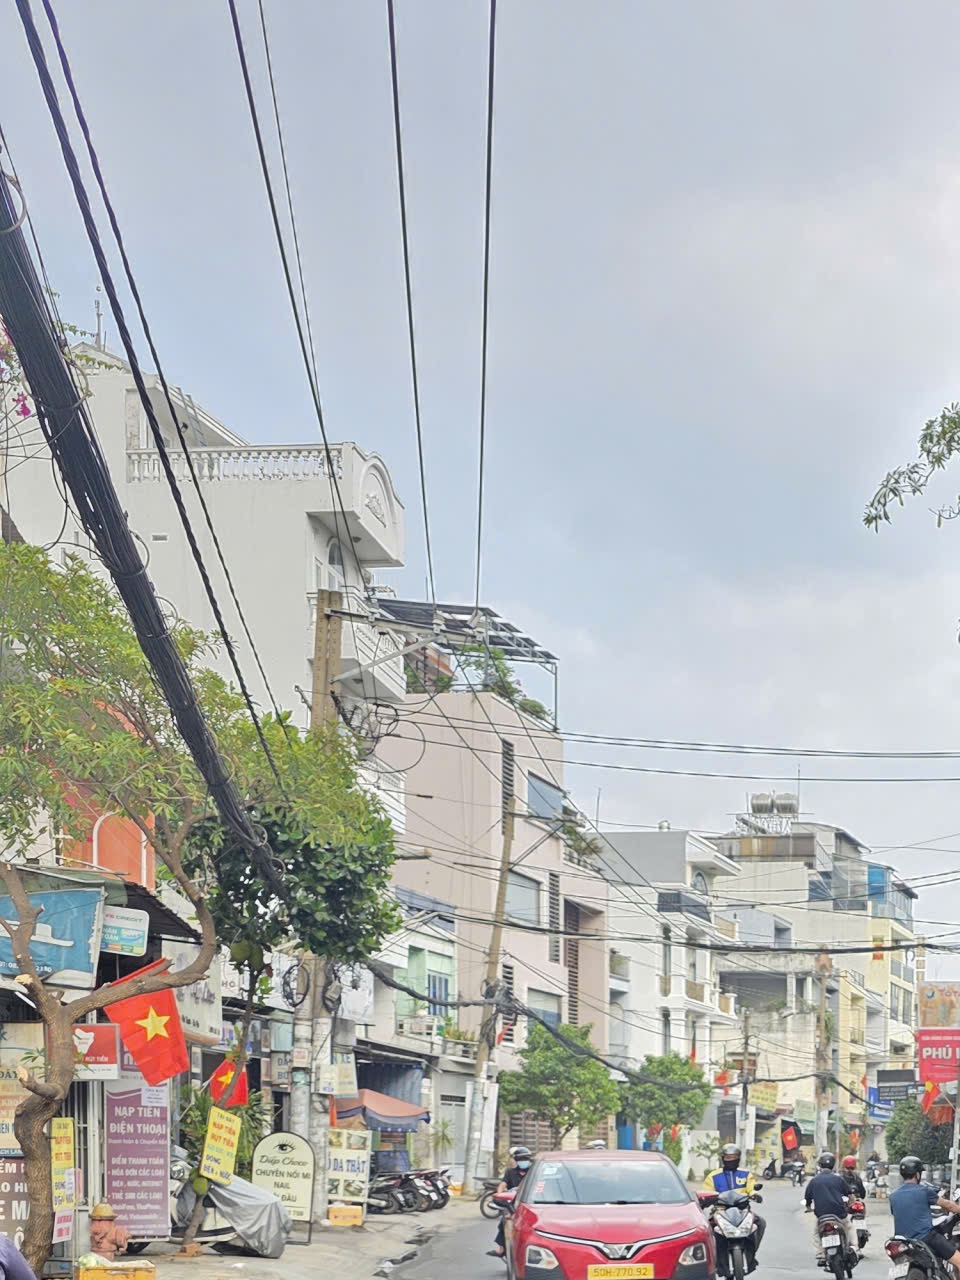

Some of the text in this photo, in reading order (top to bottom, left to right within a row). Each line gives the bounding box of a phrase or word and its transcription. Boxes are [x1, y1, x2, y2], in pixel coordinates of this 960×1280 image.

[922, 1044, 952, 1059] PHÚ
[109, 1121, 166, 1136] ĐIỆN THOẠI
[255, 1168, 285, 1178] CHUYÊN
[273, 1181, 291, 1189] NAIL
